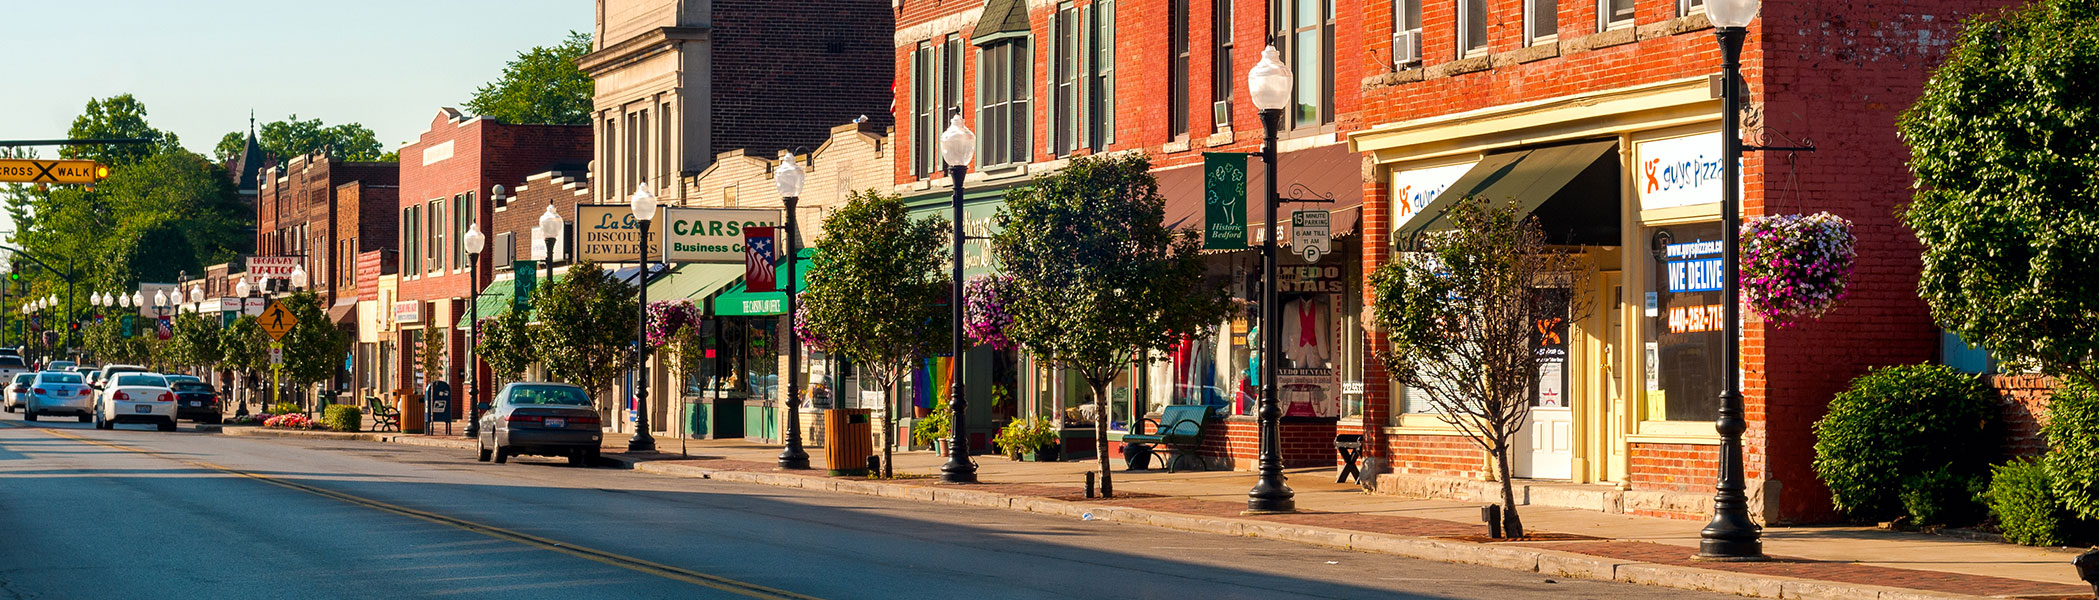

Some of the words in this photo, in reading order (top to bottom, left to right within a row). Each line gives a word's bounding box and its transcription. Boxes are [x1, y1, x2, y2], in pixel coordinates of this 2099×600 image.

[0, 167, 33, 176] ROSS
[57, 167, 90, 177] WALK
[1663, 161, 1692, 191] guys
[594, 212, 619, 230] La
[1293, 213, 1303, 225] 15
[1211, 222, 1243, 231] Historic
[1211, 230, 1243, 240] Bedford
[584, 244, 658, 255] JEWELES
[673, 242, 729, 253] Business
[1307, 249, 1316, 259] P
[253, 257, 294, 265] BROADWAY
[1668, 261, 1685, 291] WE
[1687, 258, 1723, 290] DELIVE
